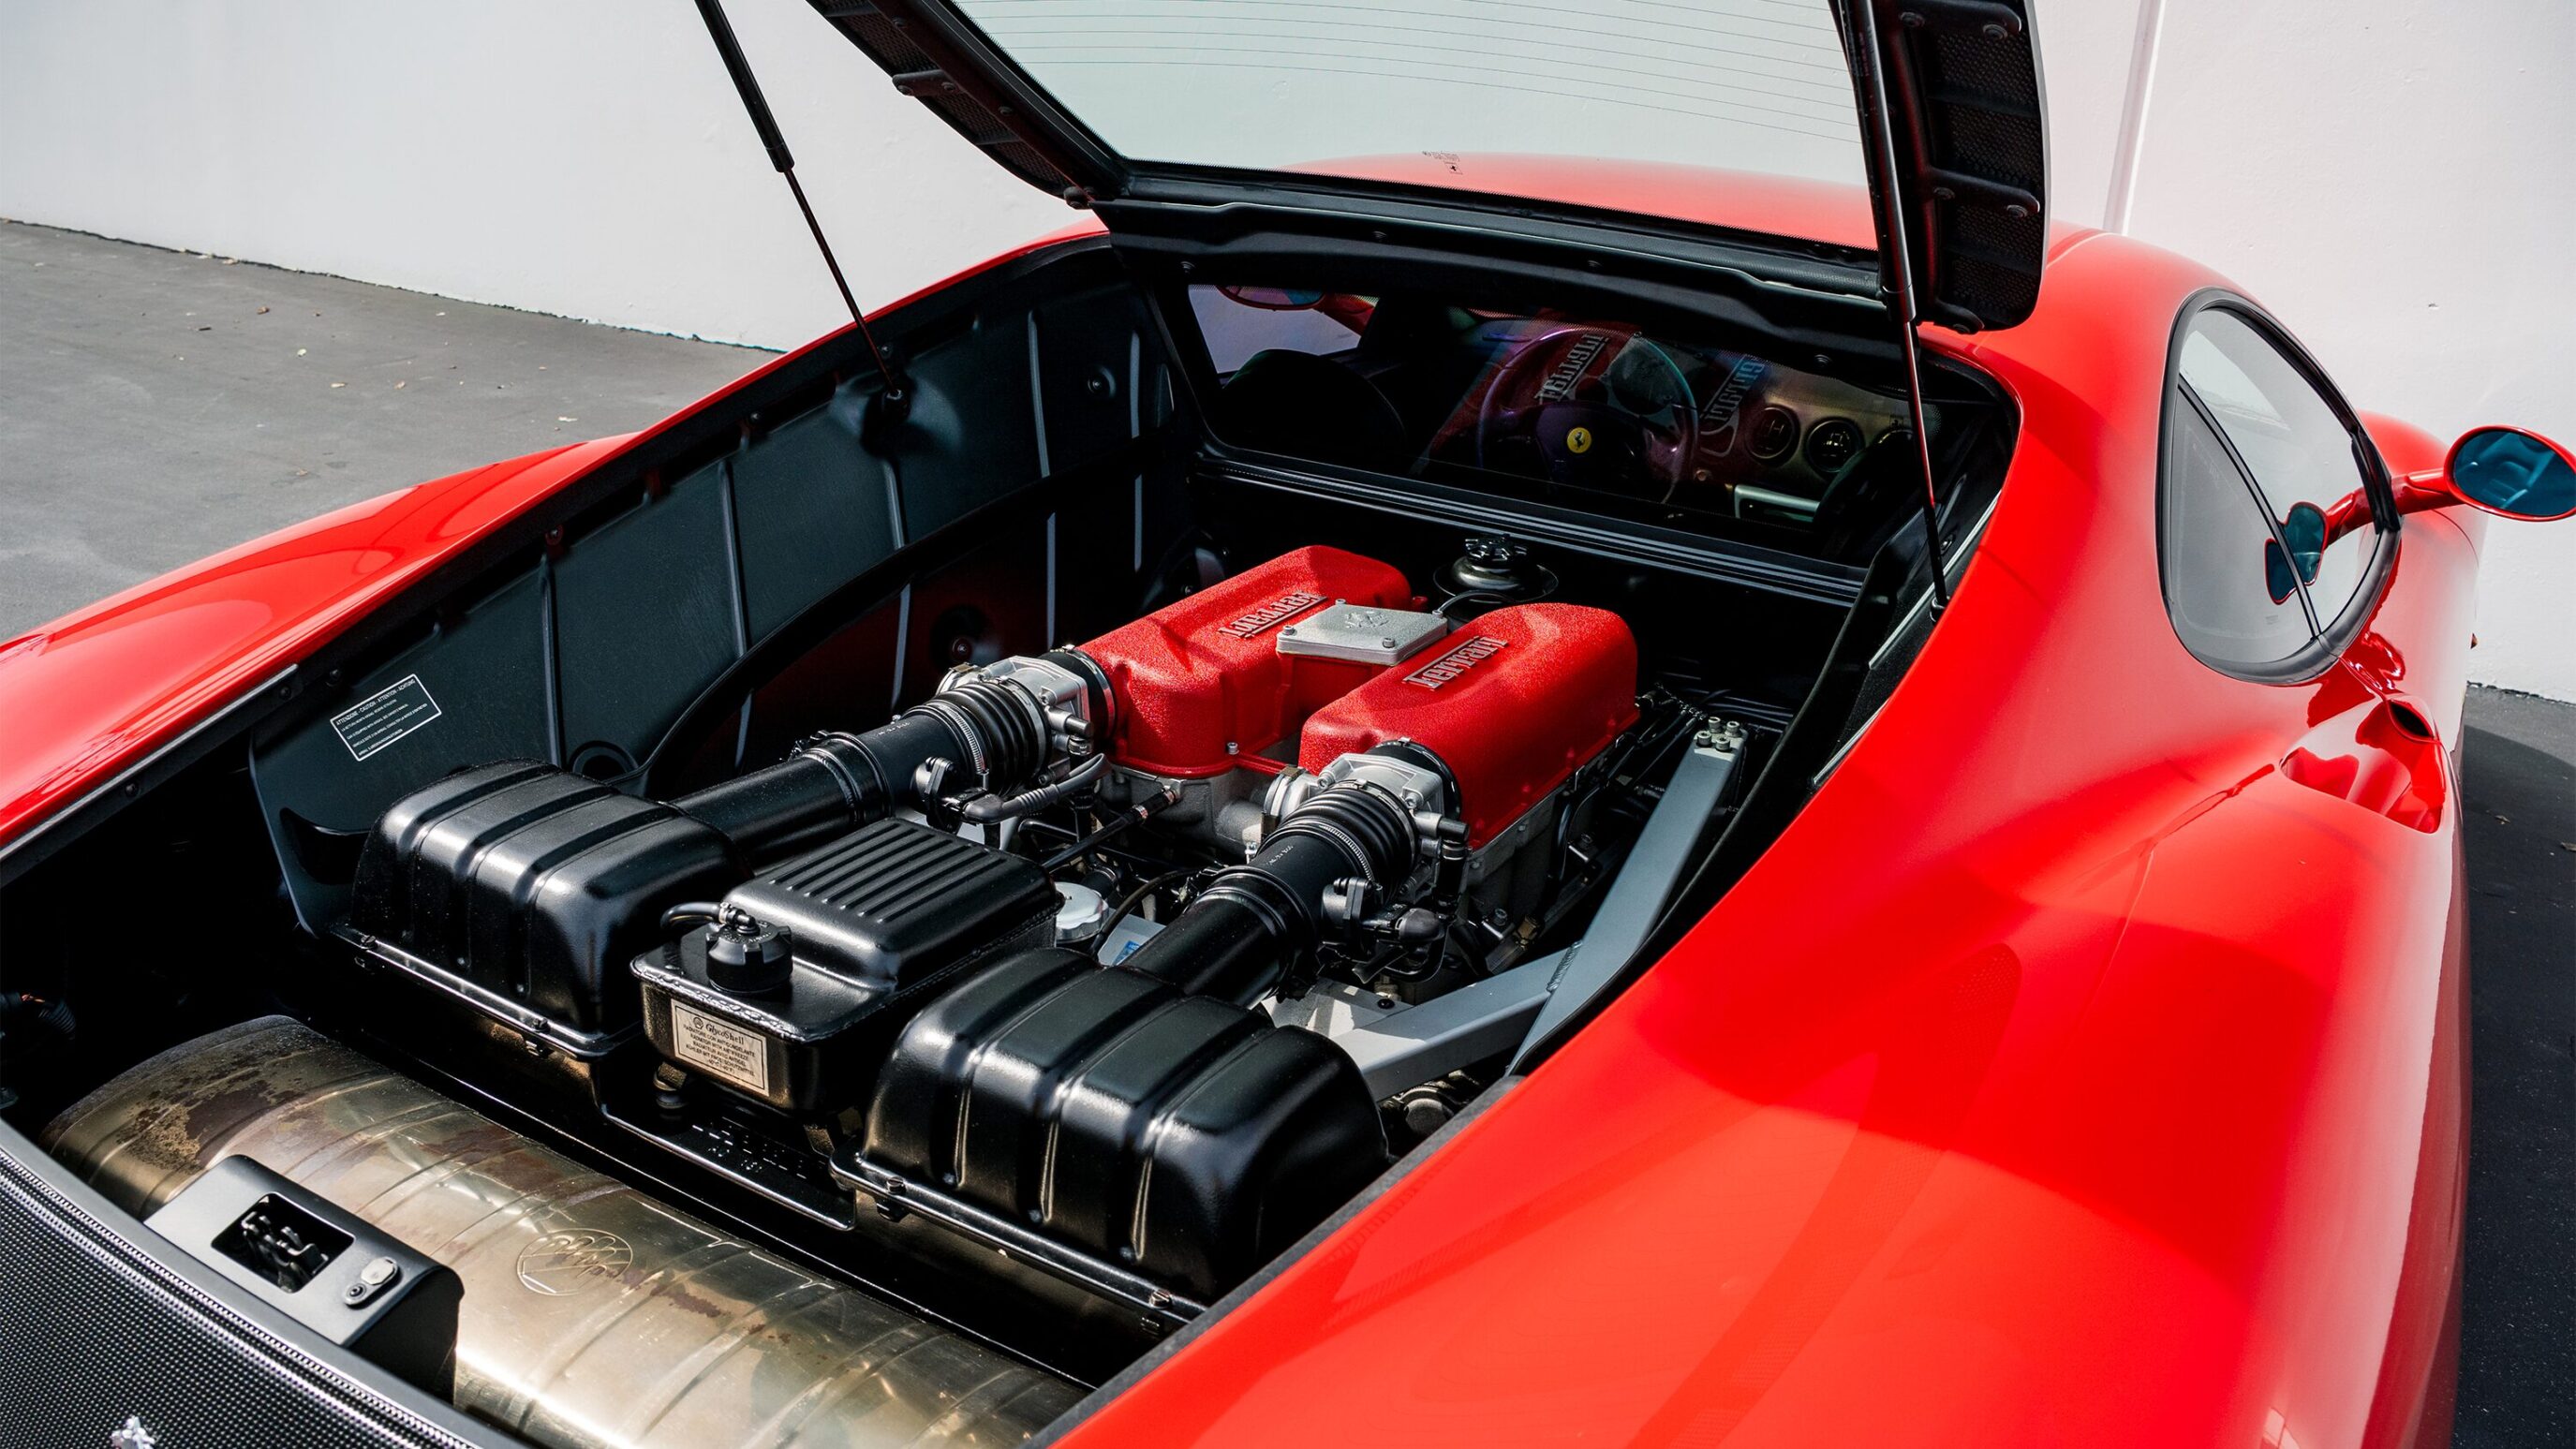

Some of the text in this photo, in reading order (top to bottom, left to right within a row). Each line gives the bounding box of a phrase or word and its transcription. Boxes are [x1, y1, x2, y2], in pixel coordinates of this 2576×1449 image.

[1218, 590, 1327, 638] Ferrari
[1402, 635, 1509, 690] Ferrari
[335, 711, 358, 725] ATTENZIONE
[359, 701, 376, 712] CAUTION
[377, 688, 396, 702] ATTENTION
[705, 1023, 744, 1045] GlycoShell
